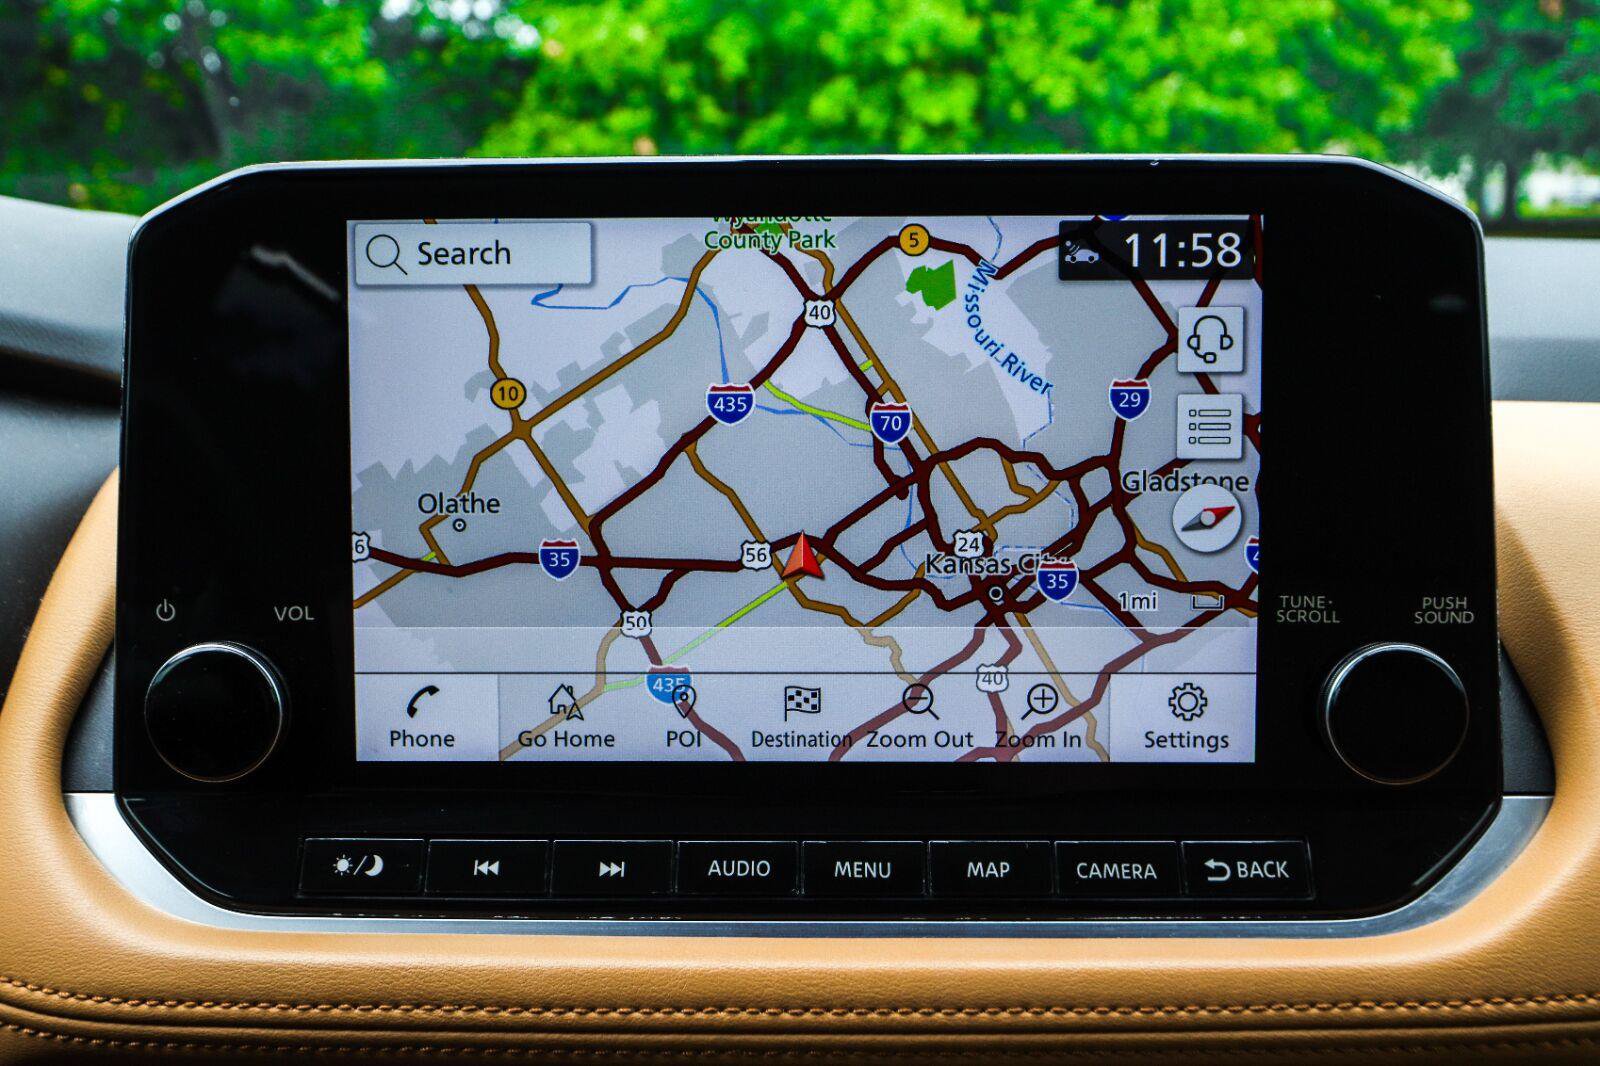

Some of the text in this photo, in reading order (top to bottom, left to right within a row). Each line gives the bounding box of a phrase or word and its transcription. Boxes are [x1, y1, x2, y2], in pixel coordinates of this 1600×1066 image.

[704, 229, 836, 253] County Park
[908, 232, 919, 248] 5
[418, 239, 511, 265] Search
[1125, 232, 1241, 268] 11:58
[809, 304, 831, 320] 40
[964, 261, 1054, 396] Missouri River
[499, 386, 519, 402] 10
[1119, 391, 1141, 408] 29
[714, 396, 748, 413] 435
[880, 415, 902, 431] 70
[418, 491, 501, 514] Olathe
[958, 536, 980, 553] 24
[549, 552, 570, 568] 35
[746, 547, 767, 562] 56
[925, 553, 1066, 575] Kansas Ci
[1046, 573, 1069, 589] 35
[1118, 591, 1158, 610] 1mi
[1422, 597, 1468, 610] PUSH
[274, 605, 314, 621] VOL
[1276, 609, 1340, 624] SCROLL
[1414, 611, 1475, 624] SOUND
[626, 615, 647, 630] 50
[652, 677, 687, 692] 435
[982, 671, 1004, 687] 40
[390, 730, 455, 748] Phone
[518, 730, 615, 748] Go Home
[667, 731, 701, 748] POI
[752, 730, 852, 748] Destination
[866, 731, 974, 748] Zoom Out
[995, 731, 1082, 748] Zoom In
[1144, 731, 1230, 753] Settings
[708, 860, 771, 877] AUDIO
[834, 861, 892, 879] MENU
[967, 862, 1010, 878] MAP
[1076, 862, 1158, 880] CAMERA
[1237, 861, 1290, 879] BACK
